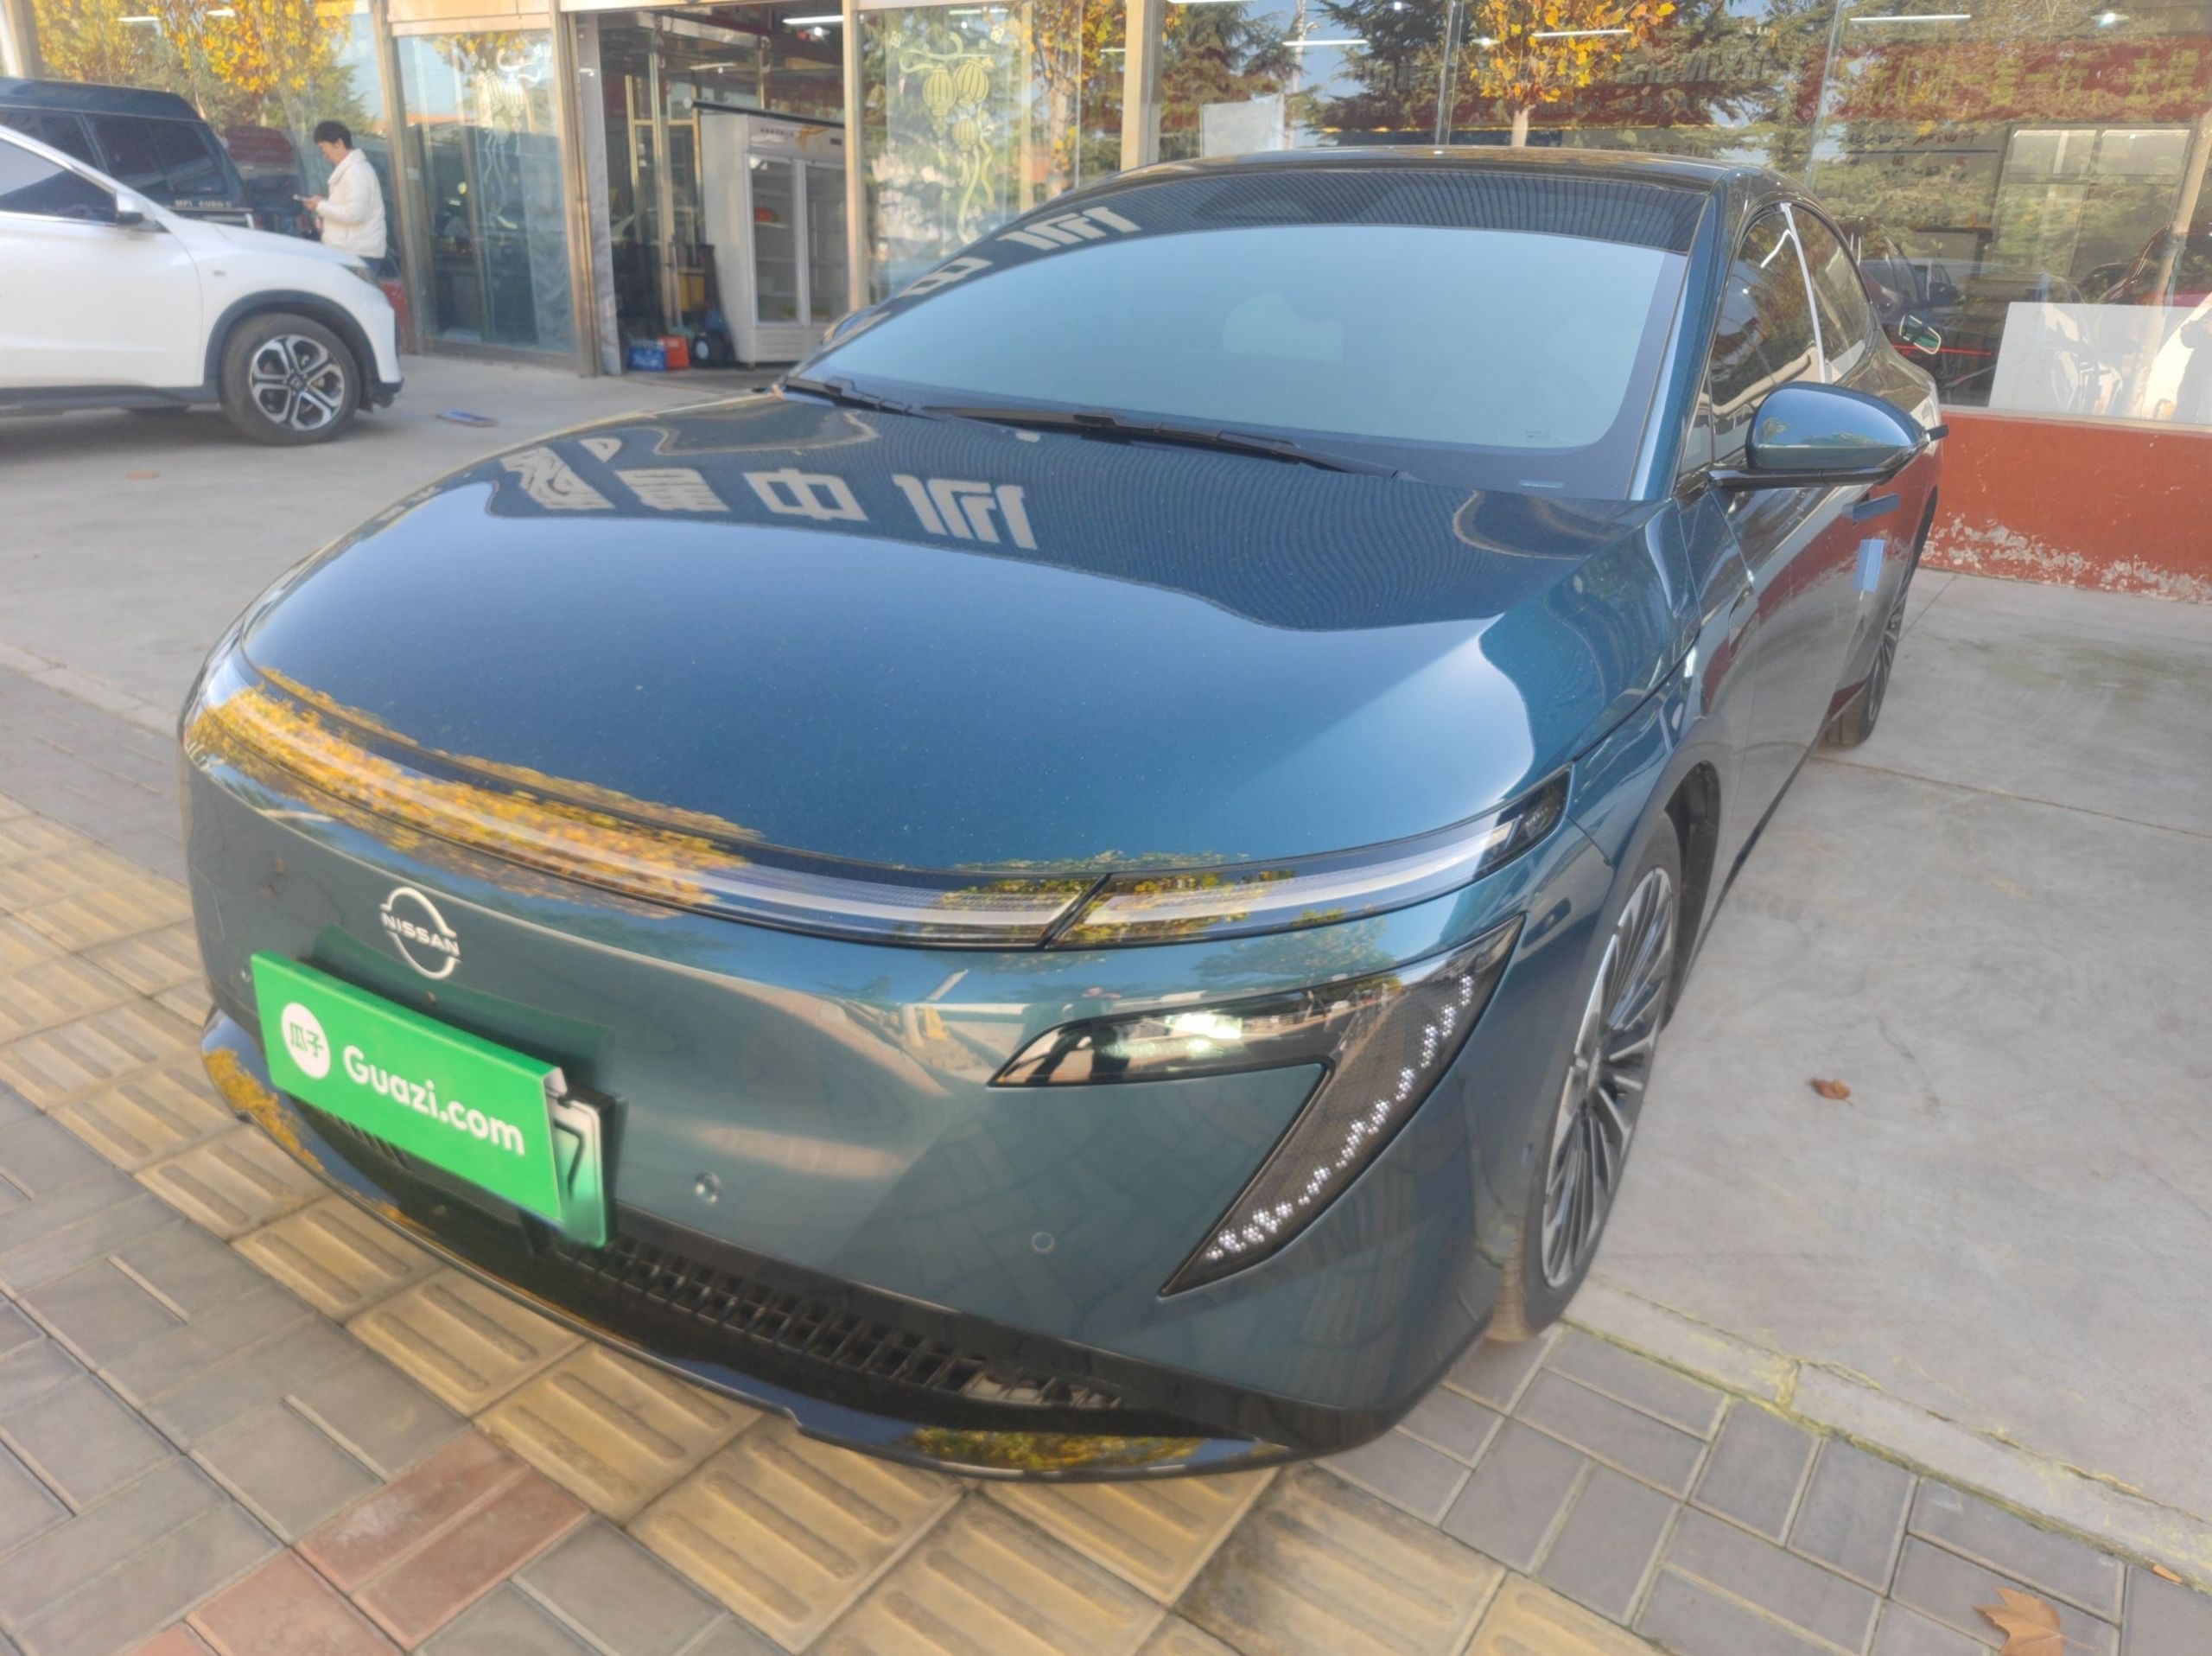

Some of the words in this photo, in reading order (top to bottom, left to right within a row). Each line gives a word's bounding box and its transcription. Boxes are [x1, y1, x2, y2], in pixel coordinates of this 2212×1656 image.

[380, 912, 461, 958] NISSAN
[289, 1022, 326, 1059] 瓜子
[341, 1044, 526, 1157] Guazi.com
